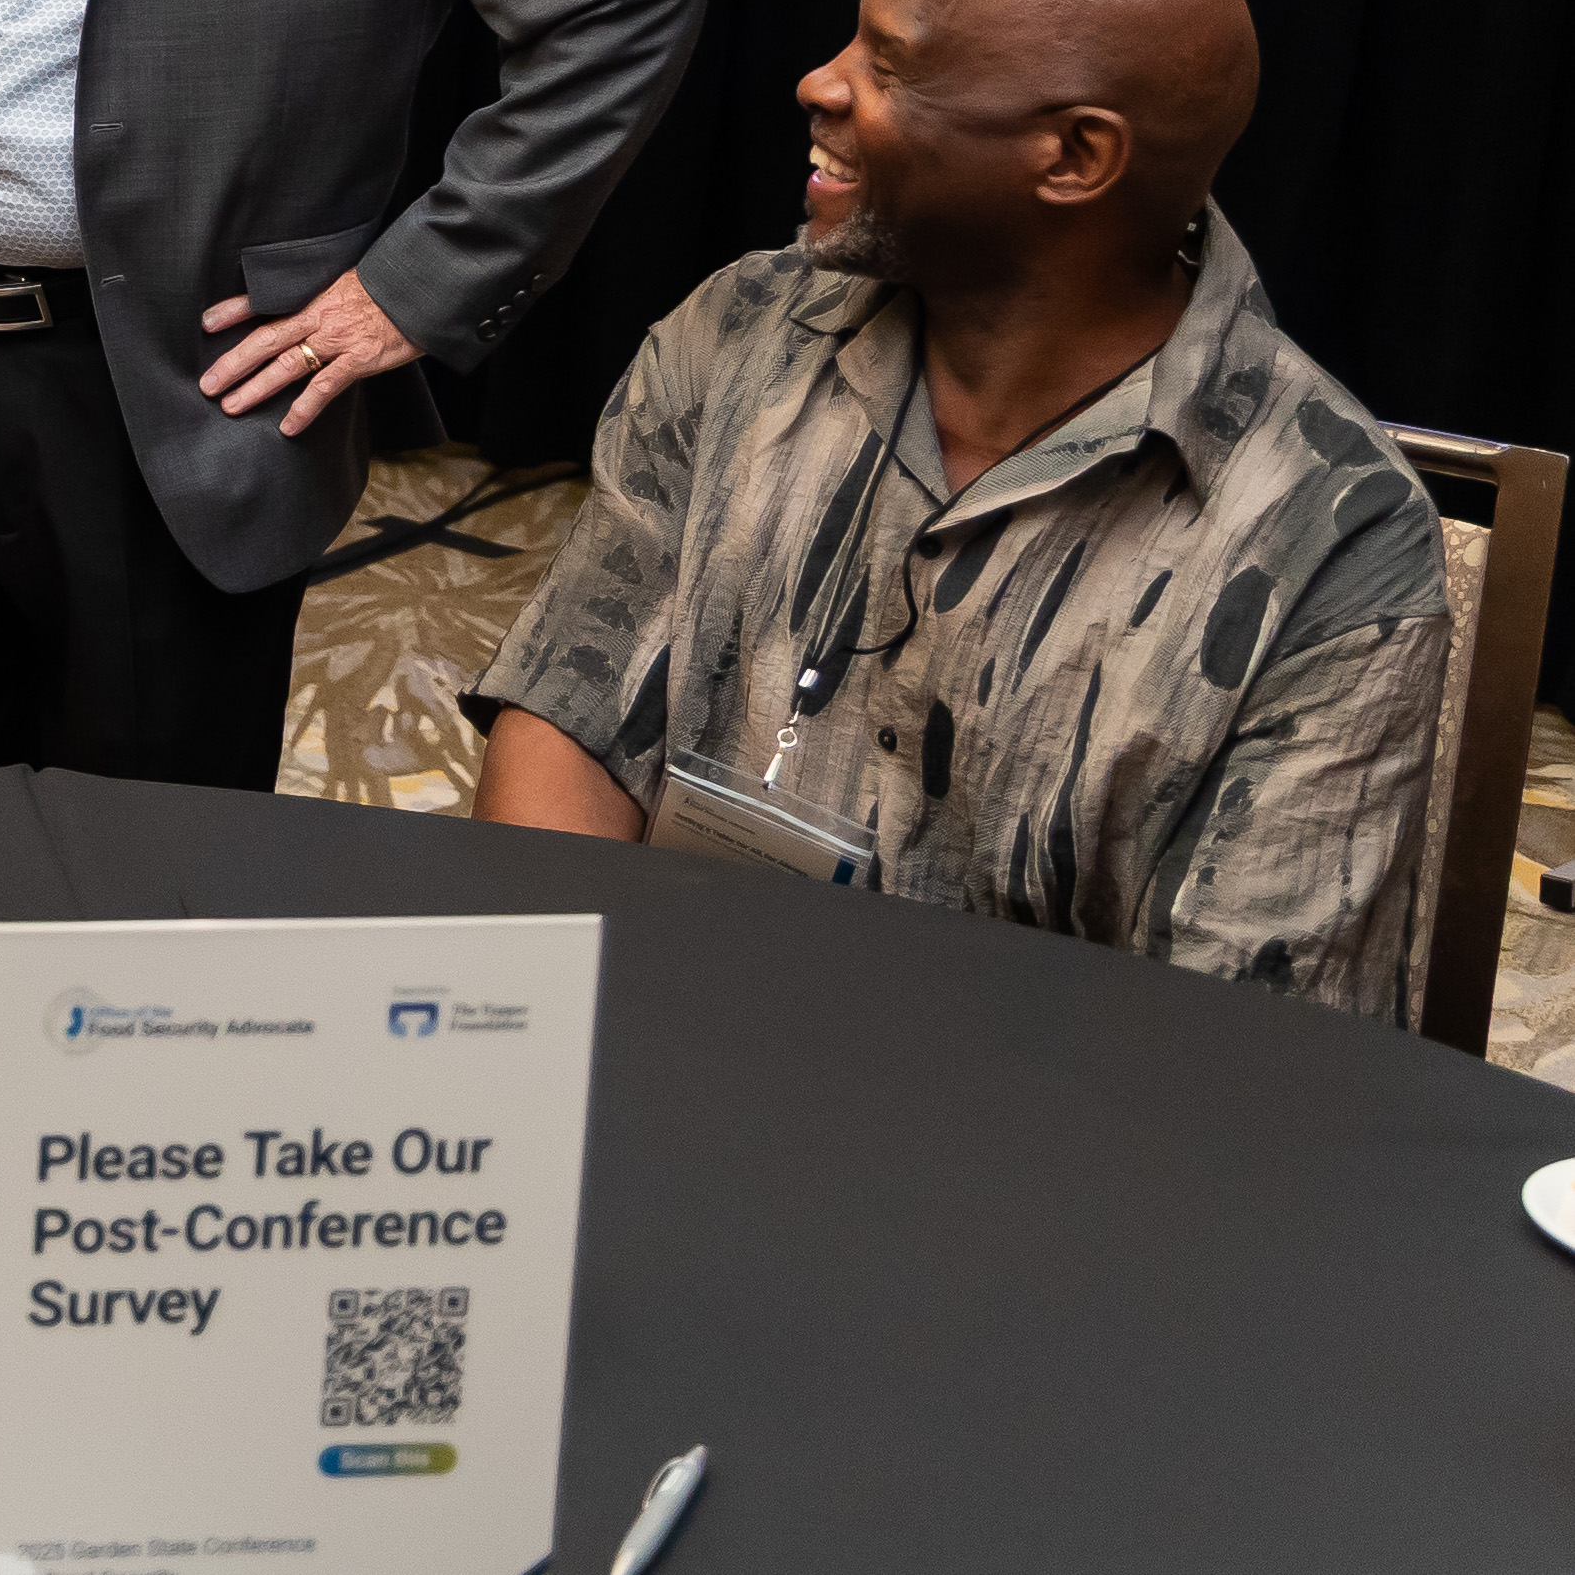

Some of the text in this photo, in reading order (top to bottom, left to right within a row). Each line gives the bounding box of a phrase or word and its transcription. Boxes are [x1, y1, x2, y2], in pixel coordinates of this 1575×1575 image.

[37, 1127, 493, 1183] Please Take Our
[33, 1200, 507, 1255] Post-Conference
[28, 1279, 220, 1336] Survey
